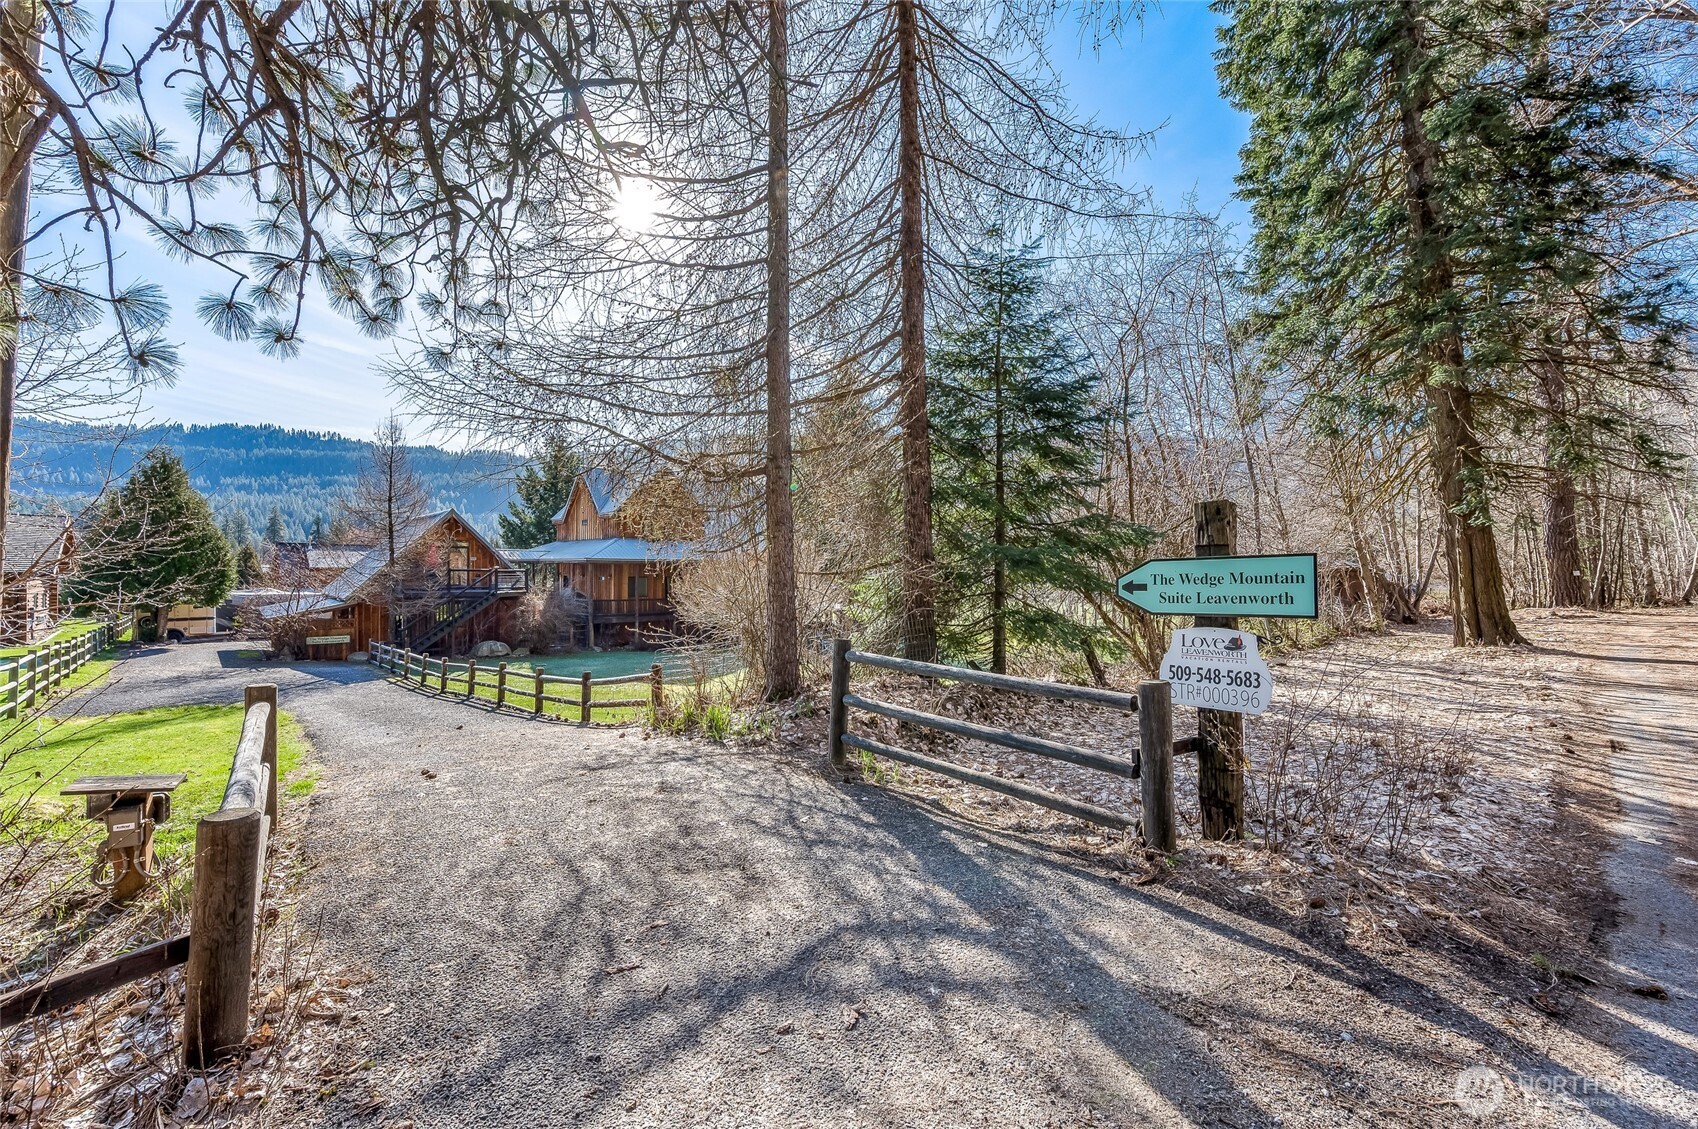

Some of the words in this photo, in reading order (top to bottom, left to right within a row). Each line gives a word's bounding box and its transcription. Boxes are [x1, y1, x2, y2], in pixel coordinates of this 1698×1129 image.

[1150, 573, 1175, 586] The
[1179, 572, 1225, 588] Wedge
[1229, 570, 1306, 585] Mountain
[1158, 591, 1193, 605] Suite
[1196, 591, 1295, 605] Leavenworth
[1181, 648, 1248, 659] LEAVENWORTH
[1168, 664, 1261, 689] 509-548-5683
[1170, 681, 1260, 709] STR#000396
